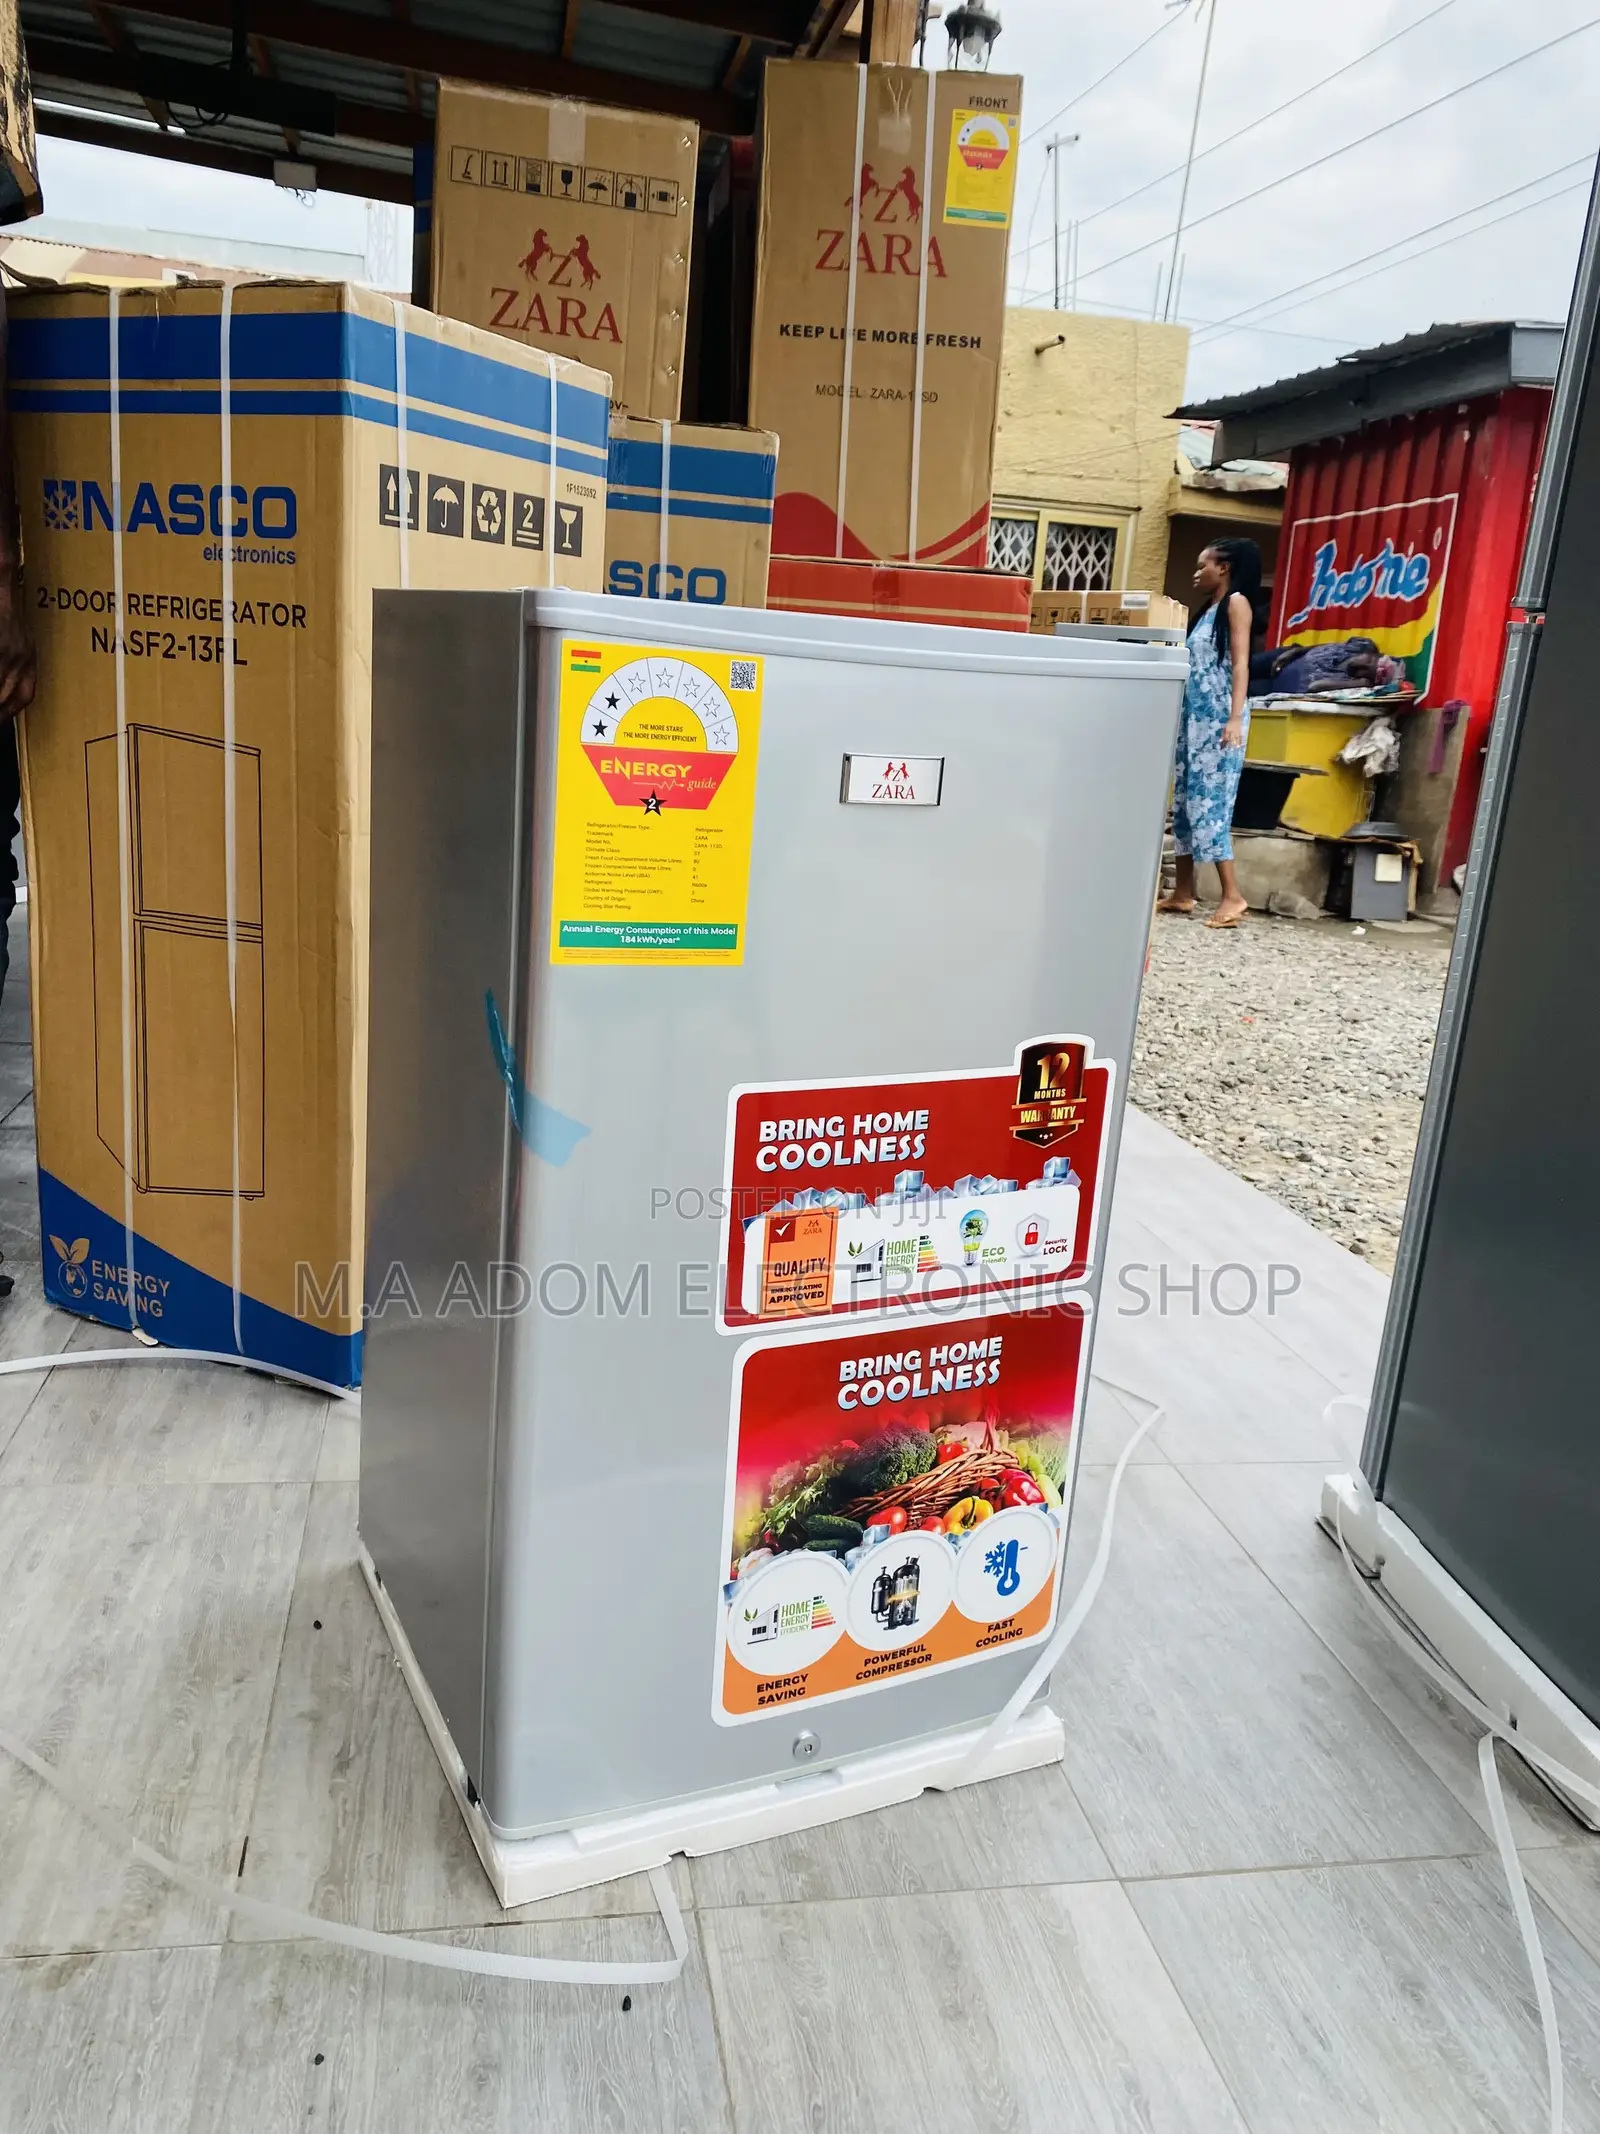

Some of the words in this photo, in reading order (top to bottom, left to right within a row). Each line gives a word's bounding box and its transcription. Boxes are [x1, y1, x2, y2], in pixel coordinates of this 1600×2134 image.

[968, 96, 1009, 109] FRONT
[874, 187, 898, 223] Z
[815, 228, 948, 278] ZARA
[548, 253, 572, 287] Z
[489, 287, 623, 344] ZARA
[779, 324, 825, 338] KEEP
[872, 329, 918, 345] MORE
[926, 333, 982, 349] FRESH
[81, 480, 297, 540] NASCO
[523, 499, 534, 528] 2
[203, 543, 297, 565] electronics
[37, 586, 118, 614] 2-DOOR
[127, 592, 307, 629] REFRIGERATOR
[672, 734, 697, 742] EFFICIENT
[600, 756, 692, 780] ENERGY
[892, 770, 900, 781] Z
[687, 777, 716, 791] guide
[872, 783, 915, 799] ZARA
[648, 798, 657, 809] 2
[562, 925, 593, 933] Annual
[595, 925, 625, 936] Energy
[626, 926, 683, 937] Consumption
[683, 927, 693, 935] of
[693, 927, 709, 935] this
[710, 927, 736, 935] Model
[1037, 1052, 1070, 1089] 12
[1034, 1088, 1067, 1100] MONTHS
[759, 1116, 845, 1143] BRING
[853, 1109, 930, 1136] HOME
[755, 1133, 926, 1172] COOLNESS
[886, 1238, 917, 1254] HOME
[982, 1247, 1005, 1258] ECO
[1043, 1245, 1067, 1256] LOCK
[774, 1257, 826, 1277] QUALITY
[886, 1254, 916, 1268] ENERGY
[92, 1260, 170, 1297] ENERGY
[885, 1267, 916, 1277] EFFICIENCY
[93, 1282, 163, 1317] SAVNG
[769, 1291, 824, 1304] APPROVED
[771, 1286, 797, 1294] ENERGY
[839, 1350, 922, 1382] BRING
[929, 1336, 1003, 1368] HOME
[837, 1358, 1001, 1410] COOLNESS
[781, 1600, 811, 1617] HOME
[780, 1612, 811, 1627] ENERGY
[986, 1618, 1015, 1634] FAST
[780, 1624, 810, 1636] EFFICIENCY
[975, 1627, 1023, 1648] COOLING
[864, 1644, 927, 1667] POWERFUL
[856, 1653, 932, 1681] COMPRESSOR
[756, 1674, 809, 1694] ENERGY
[758, 1687, 806, 1706] SAVING
